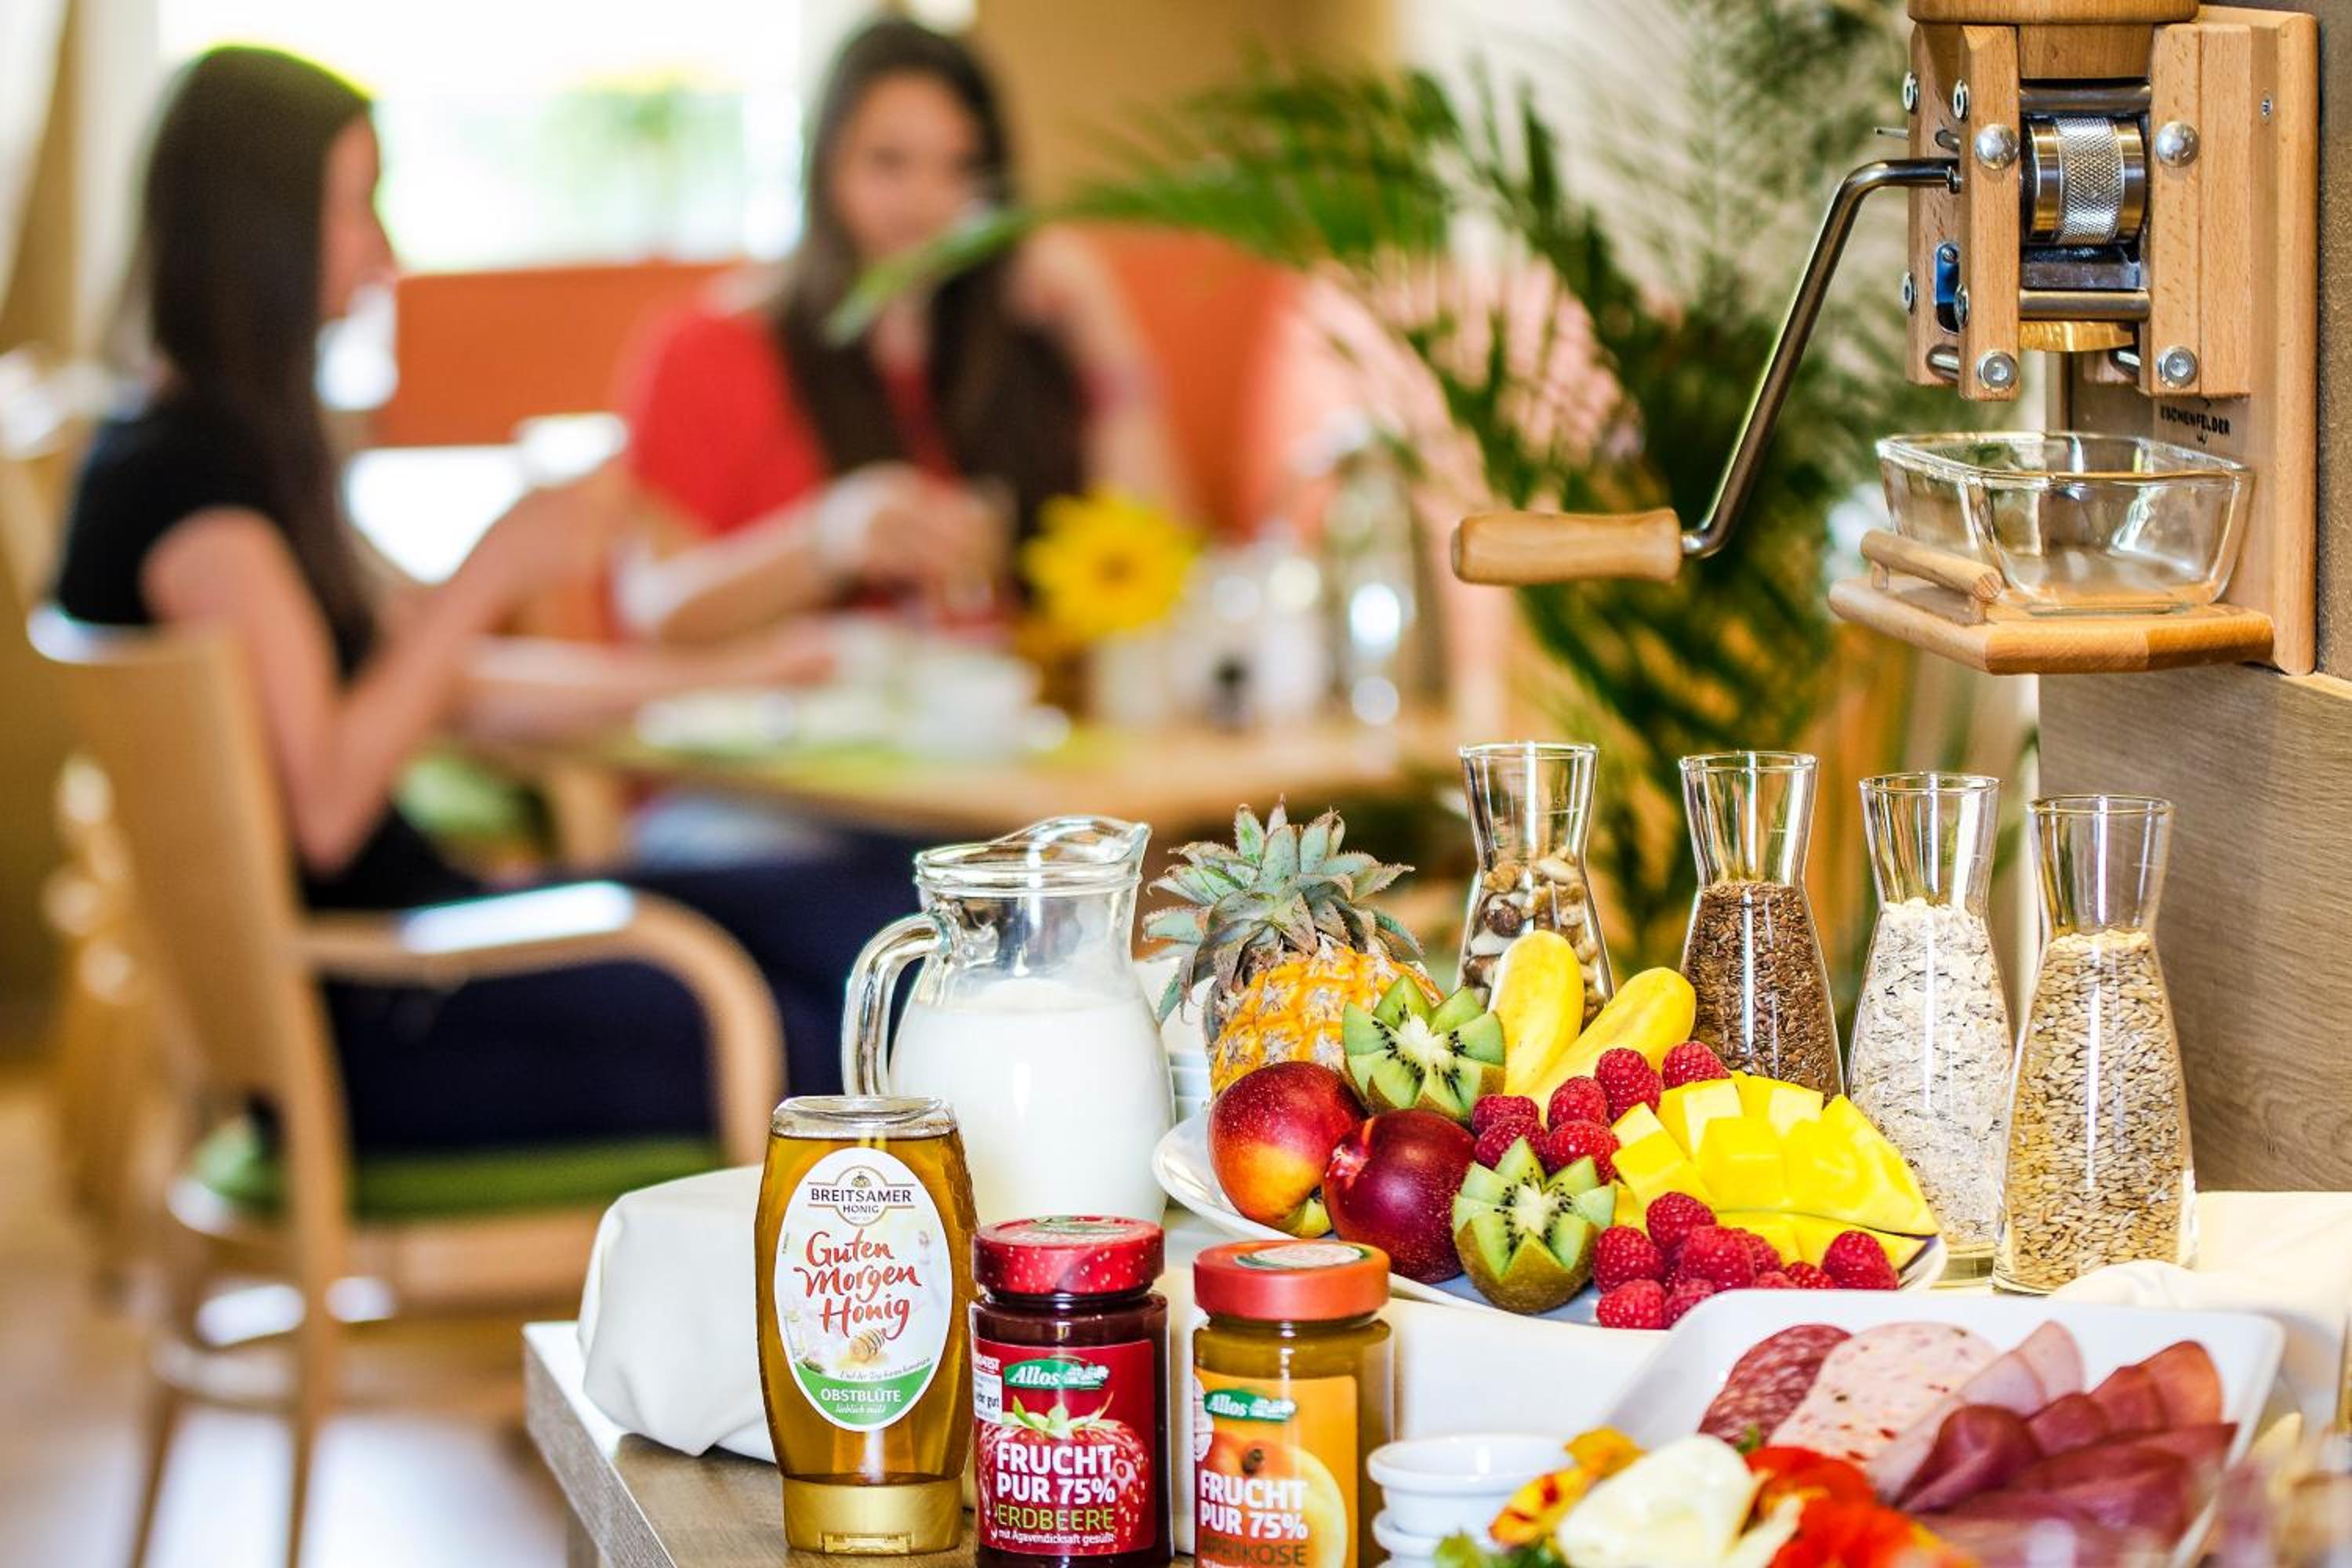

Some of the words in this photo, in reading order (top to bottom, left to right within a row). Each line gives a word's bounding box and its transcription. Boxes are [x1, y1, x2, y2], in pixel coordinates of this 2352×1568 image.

[811, 1188, 912, 1203] BREITSAMER
[843, 1204, 879, 1214] HONIG
[805, 1229, 895, 1268] Guten
[793, 1265, 922, 1303] Morgen
[818, 1294, 910, 1341] Honig
[1010, 1366, 1059, 1385] Allos
[820, 1386, 902, 1403] OBSTBLÜTE
[1207, 1394, 1247, 1417] Allos
[996, 1442, 1116, 1475] FRUCHT
[996, 1471, 1051, 1503] PUR
[1056, 1477, 1116, 1504] 75%
[1200, 1469, 1308, 1510] FRUCHT
[997, 1504, 1116, 1531] ERDBEERE
[1200, 1500, 1243, 1537] PUR
[1247, 1512, 1308, 1540] 75%
